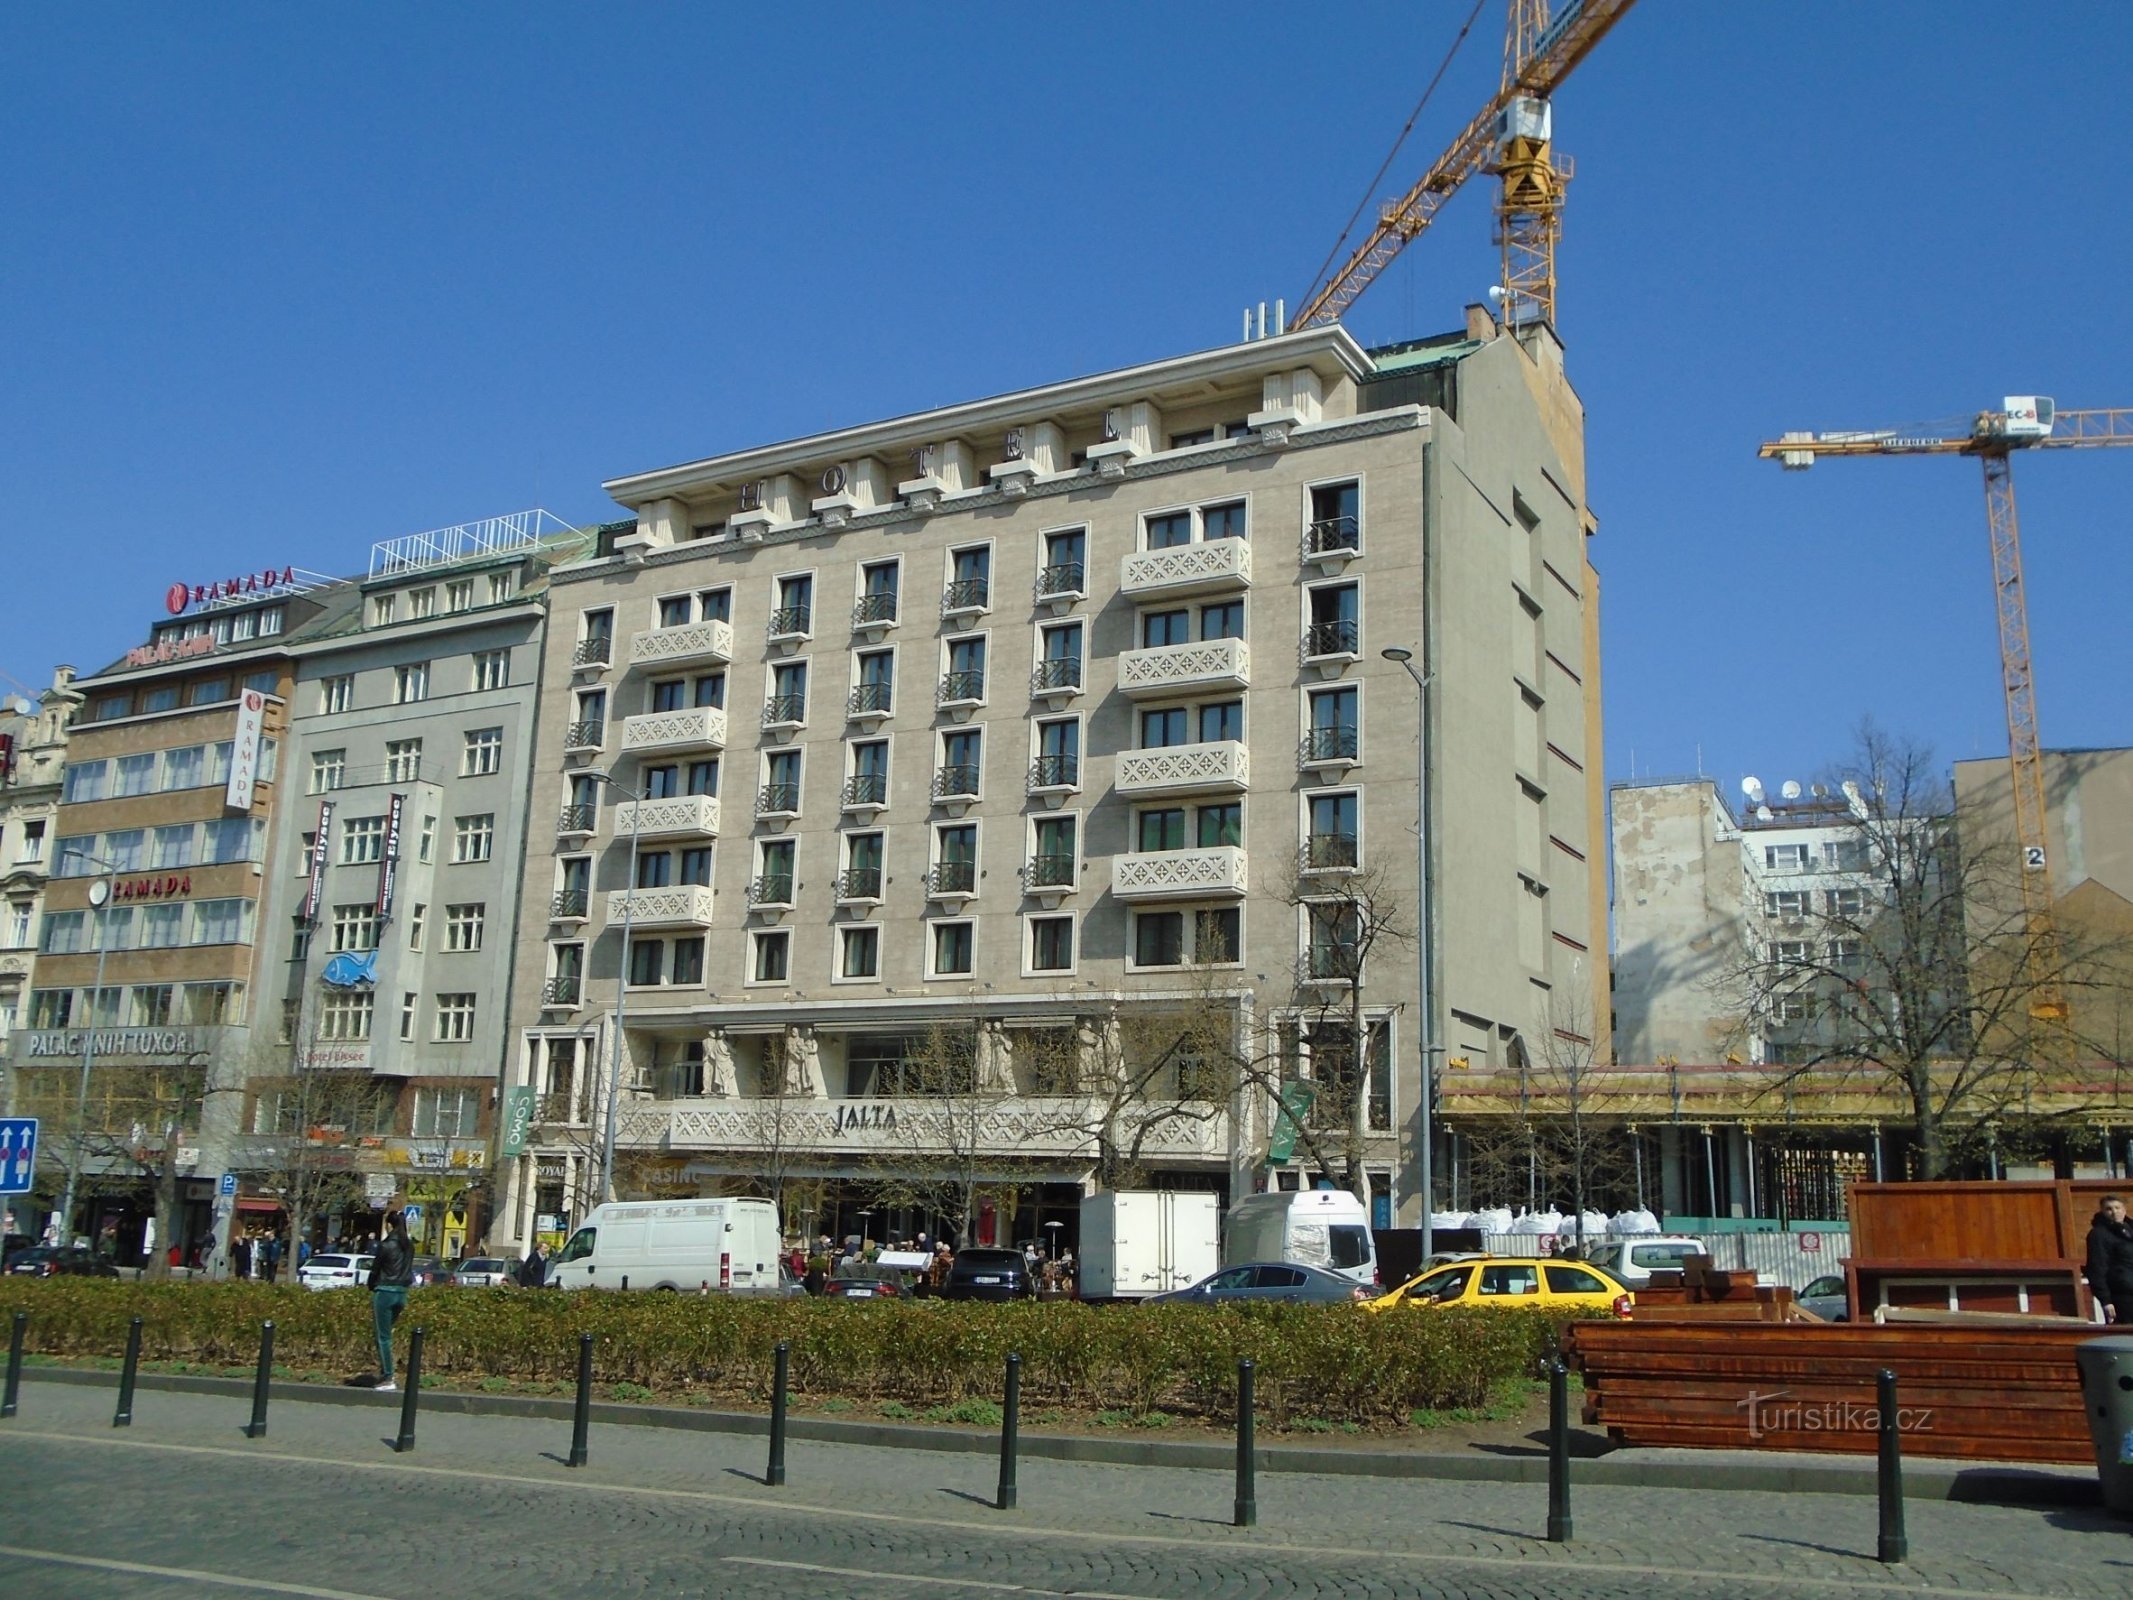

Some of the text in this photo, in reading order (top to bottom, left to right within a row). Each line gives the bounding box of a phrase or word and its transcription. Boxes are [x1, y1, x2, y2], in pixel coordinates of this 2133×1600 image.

[741, 409, 1122, 511] HOTEL
[194, 565, 294, 603] RAMADA
[236, 719, 255, 807] RAMADA
[2028, 848, 2044, 865] 2
[113, 875, 192, 899] RAMADA
[509, 1096, 531, 1146] COMO
[832, 1105, 897, 1136] JALTA
